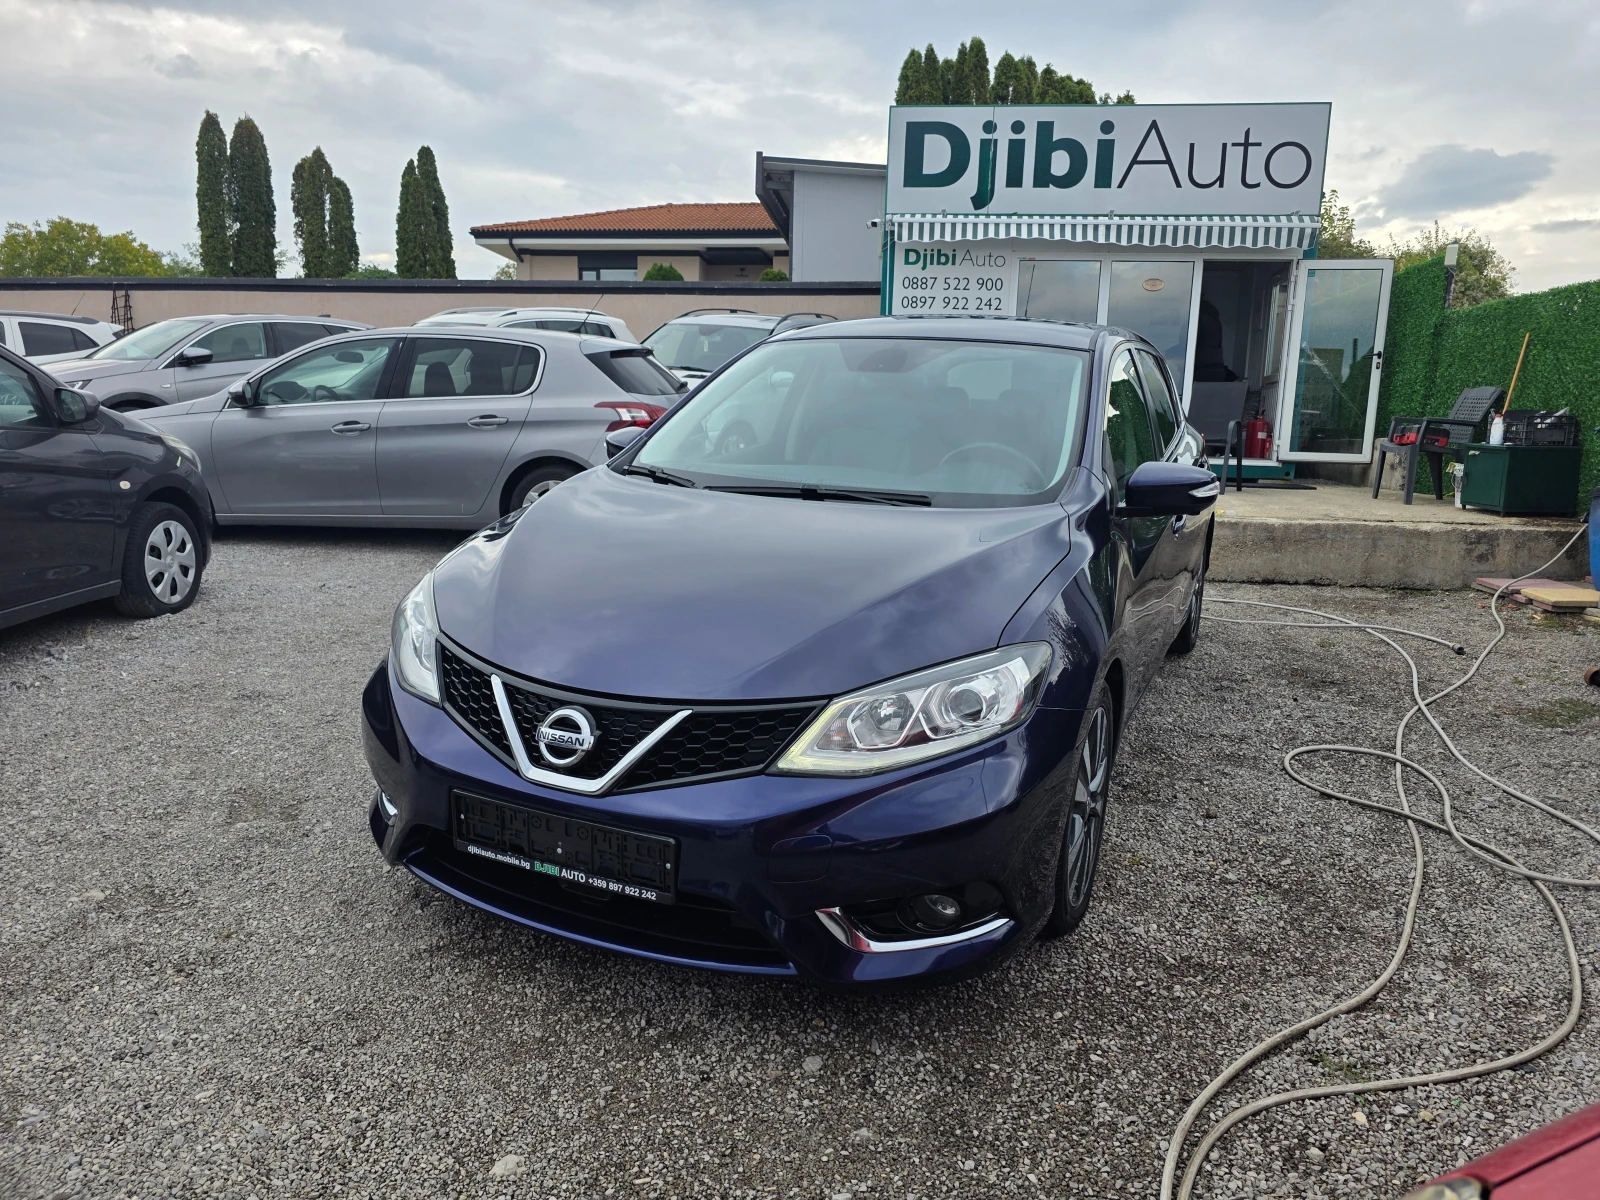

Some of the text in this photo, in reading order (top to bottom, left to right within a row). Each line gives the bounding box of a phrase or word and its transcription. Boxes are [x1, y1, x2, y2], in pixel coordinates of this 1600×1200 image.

[902, 276, 1003, 291] 0887 522 900
[901, 296, 1002, 311] 0897 922 242
[539, 730, 585, 747] NISSAN
[534, 861, 560, 876] DJIBI
[561, 868, 586, 883] AUTO
[588, 877, 607, 889] +359
[608, 881, 623, 892] 897
[624, 886, 640, 897] 922
[641, 890, 657, 900] 242
